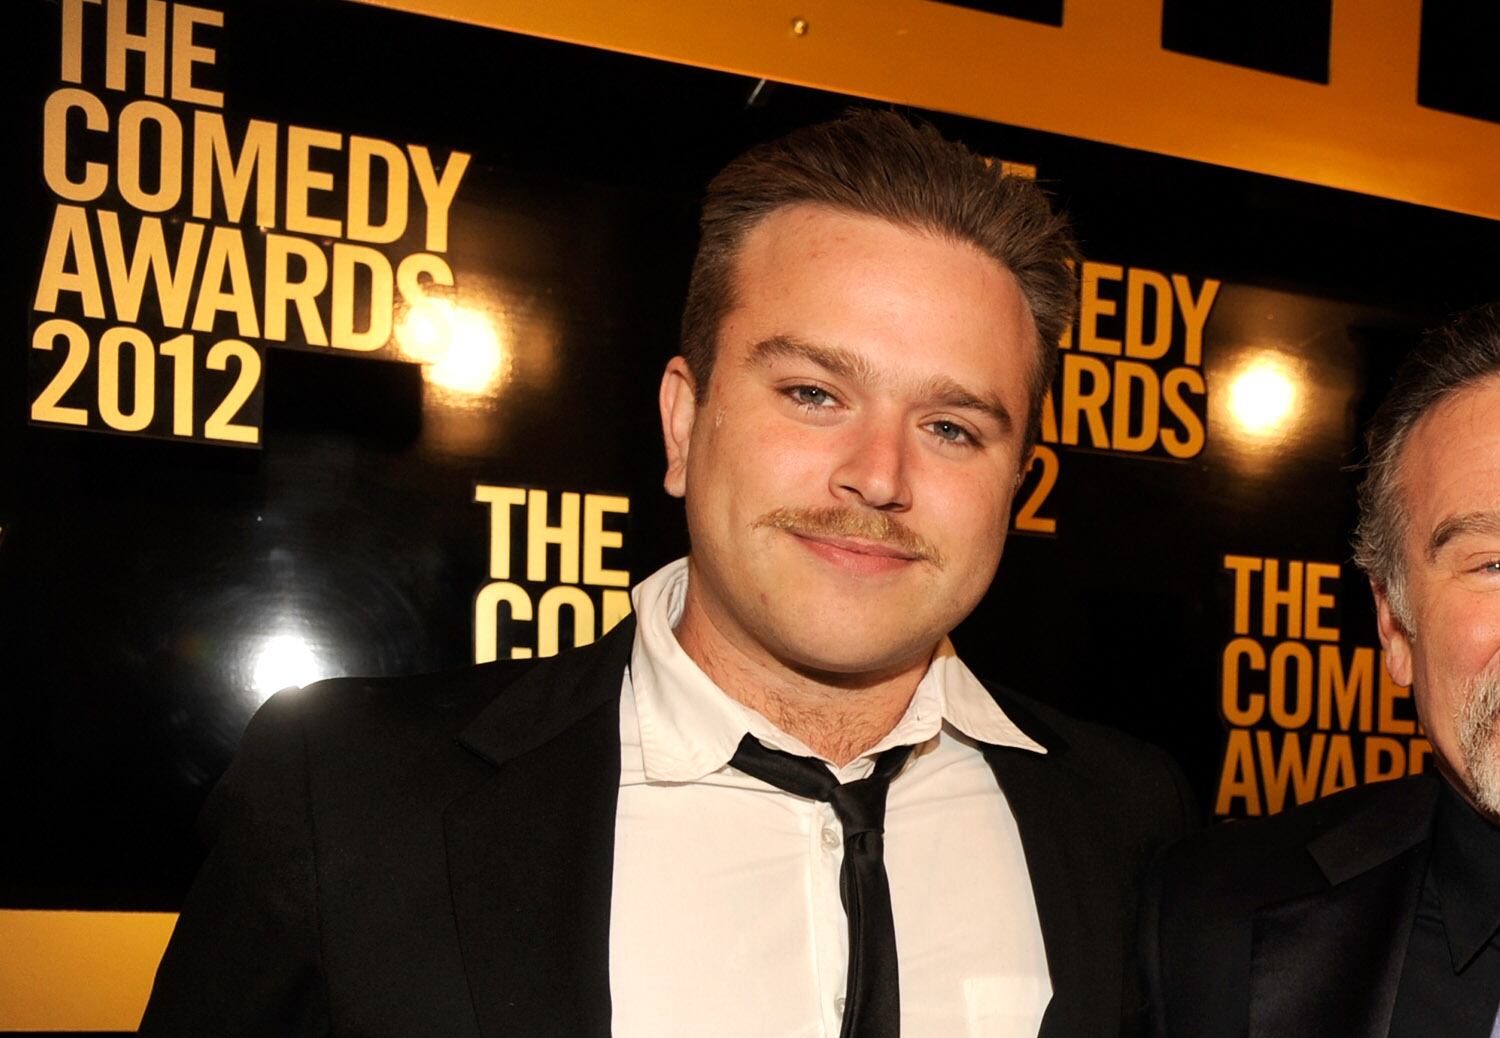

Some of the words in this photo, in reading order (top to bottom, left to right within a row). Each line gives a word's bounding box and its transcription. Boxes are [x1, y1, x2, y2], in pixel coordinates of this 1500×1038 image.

[62, 0, 224, 108] THE
[43, 88, 471, 253] COMEDY
[34, 204, 455, 364] AWARDS
[1060, 257, 1221, 366] EDY
[31, 320, 262, 443] 2012
[475, 484, 630, 587] THE
[1224, 555, 1340, 642] THE
[1222, 637, 1426, 735] COME
